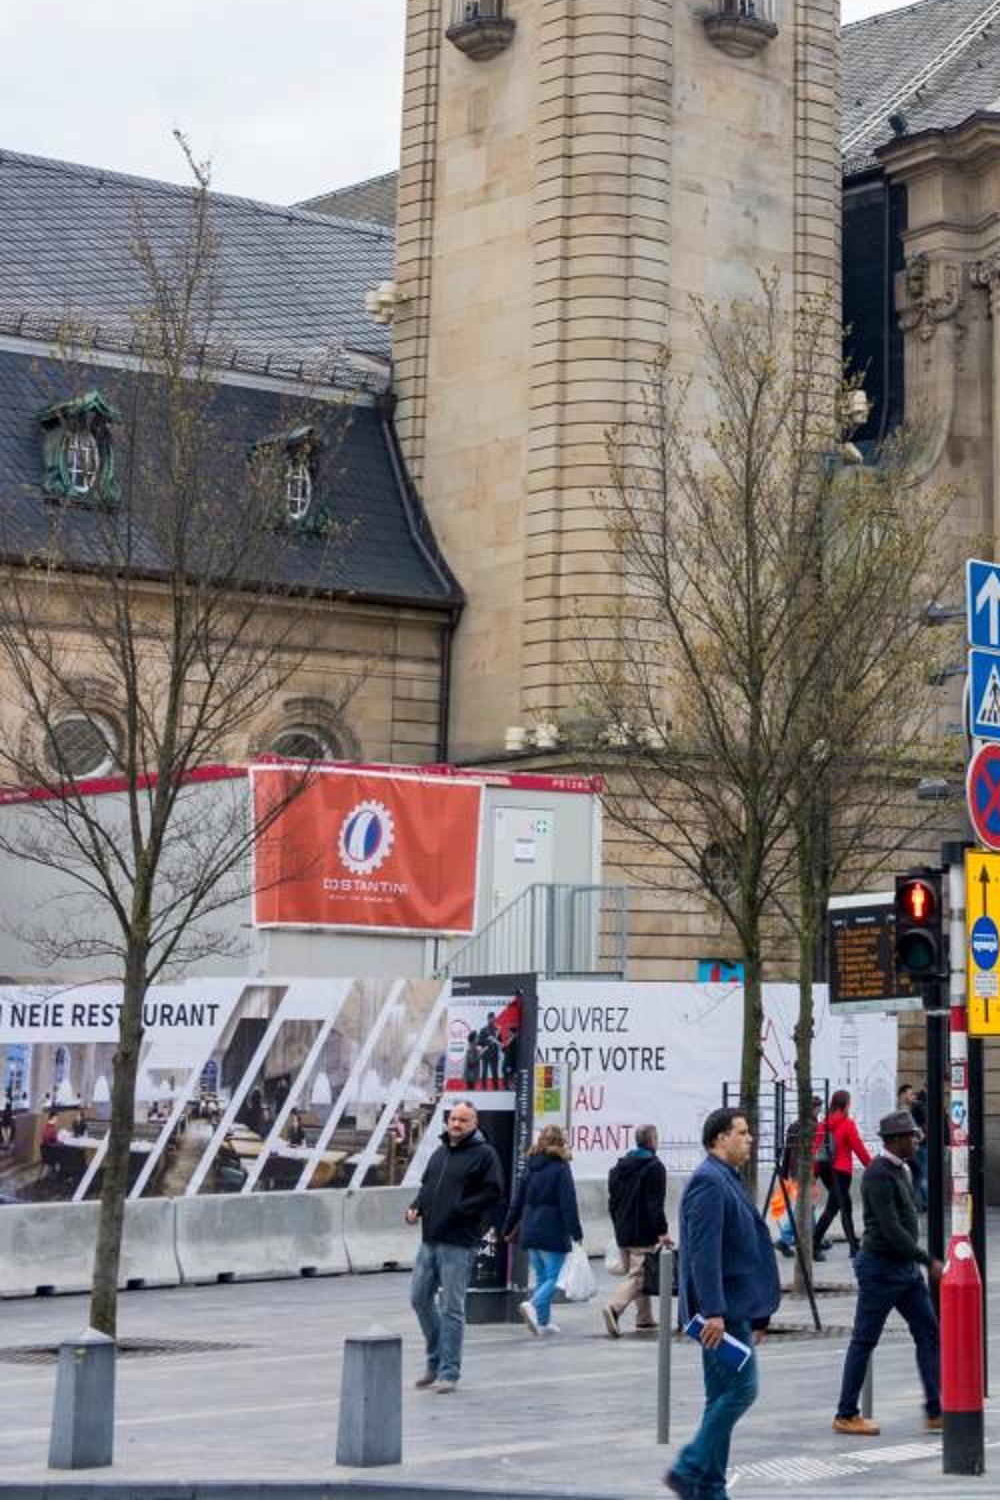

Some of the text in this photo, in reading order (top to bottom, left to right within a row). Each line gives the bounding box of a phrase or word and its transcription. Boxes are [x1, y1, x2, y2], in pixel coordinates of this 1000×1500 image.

[11, 1003, 64, 1027] NEIE
[72, 1003, 219, 1027] RESTURANT
[599, 1046, 665, 1071] VOTRE
[576, 1085, 604, 1111] AU
